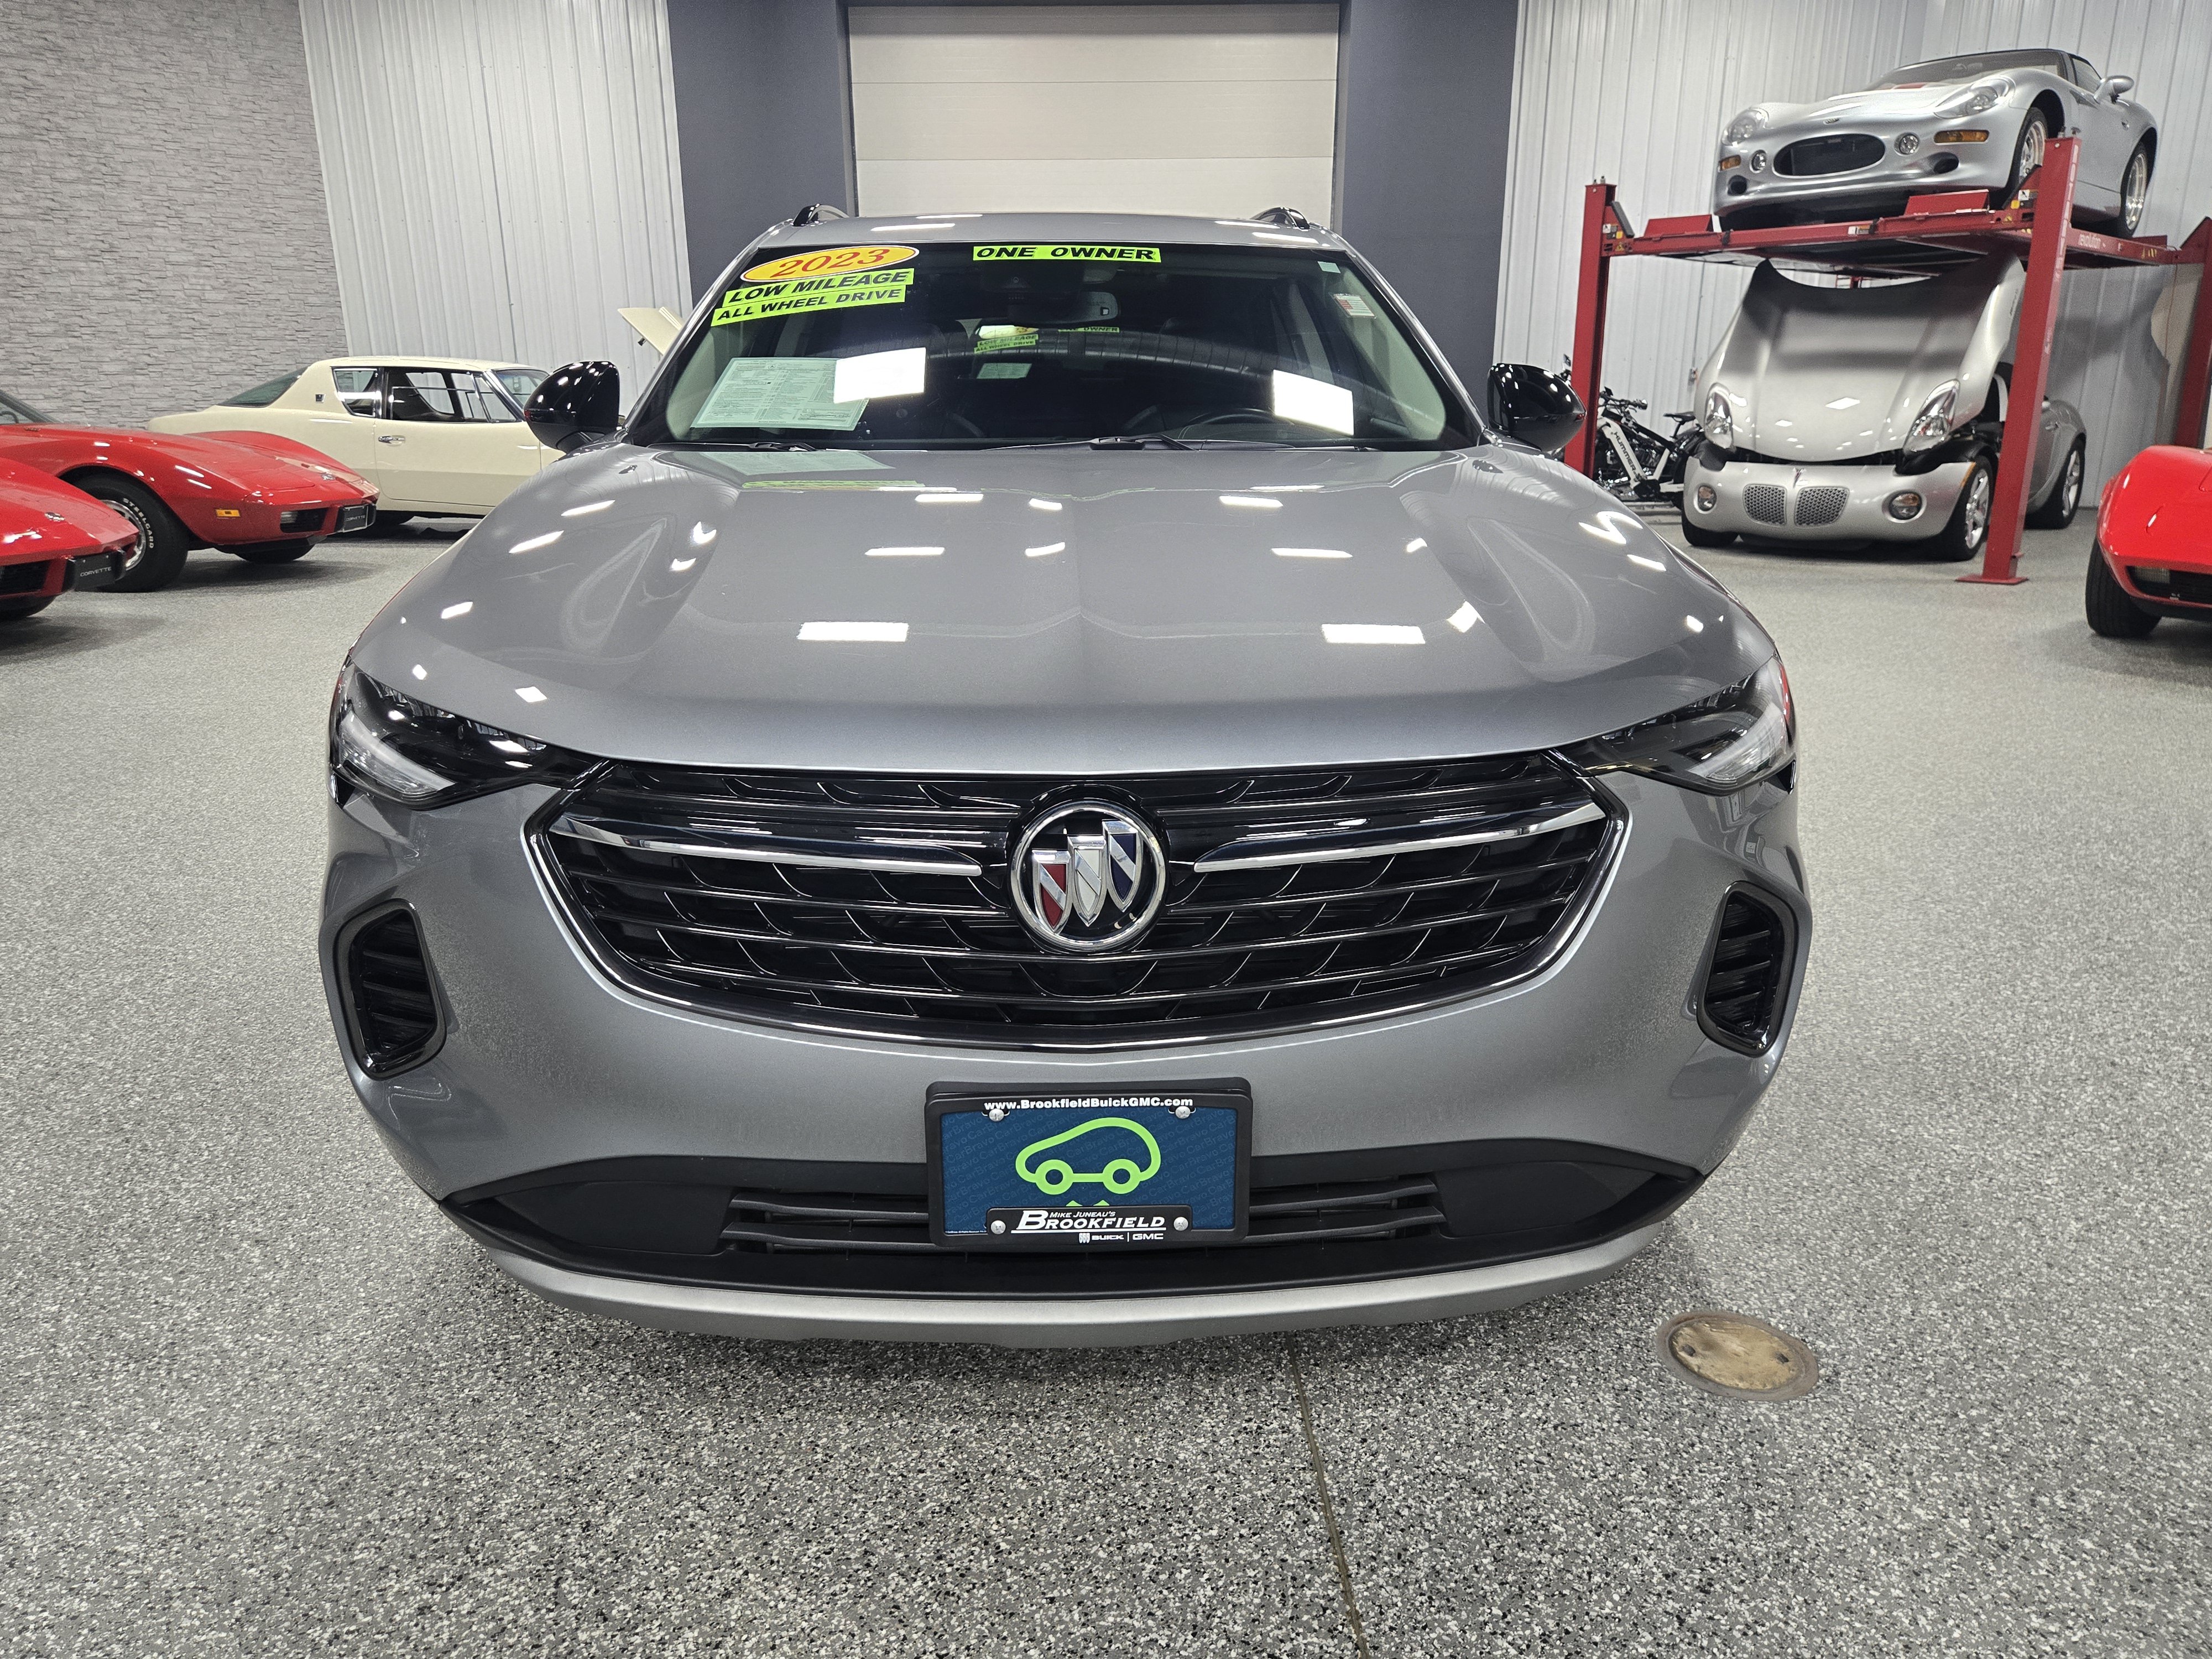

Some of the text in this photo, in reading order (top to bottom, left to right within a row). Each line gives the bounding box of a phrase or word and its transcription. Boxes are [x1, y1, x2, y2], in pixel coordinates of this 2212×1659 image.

[770, 249, 890, 278] 2023
[977, 247, 1157, 260] ONE OWNER
[728, 271, 911, 304] LOW MILEAGE
[717, 289, 902, 321] ALL WHEEL DRIVE
[1613, 432, 1637, 472] HUMMER
[80, 566, 112, 577] CORVETTE
[984, 1097, 1193, 1110] www.BrookfieldBuickGMC.com
[1016, 1210, 1165, 1230] BROOKFIELD
